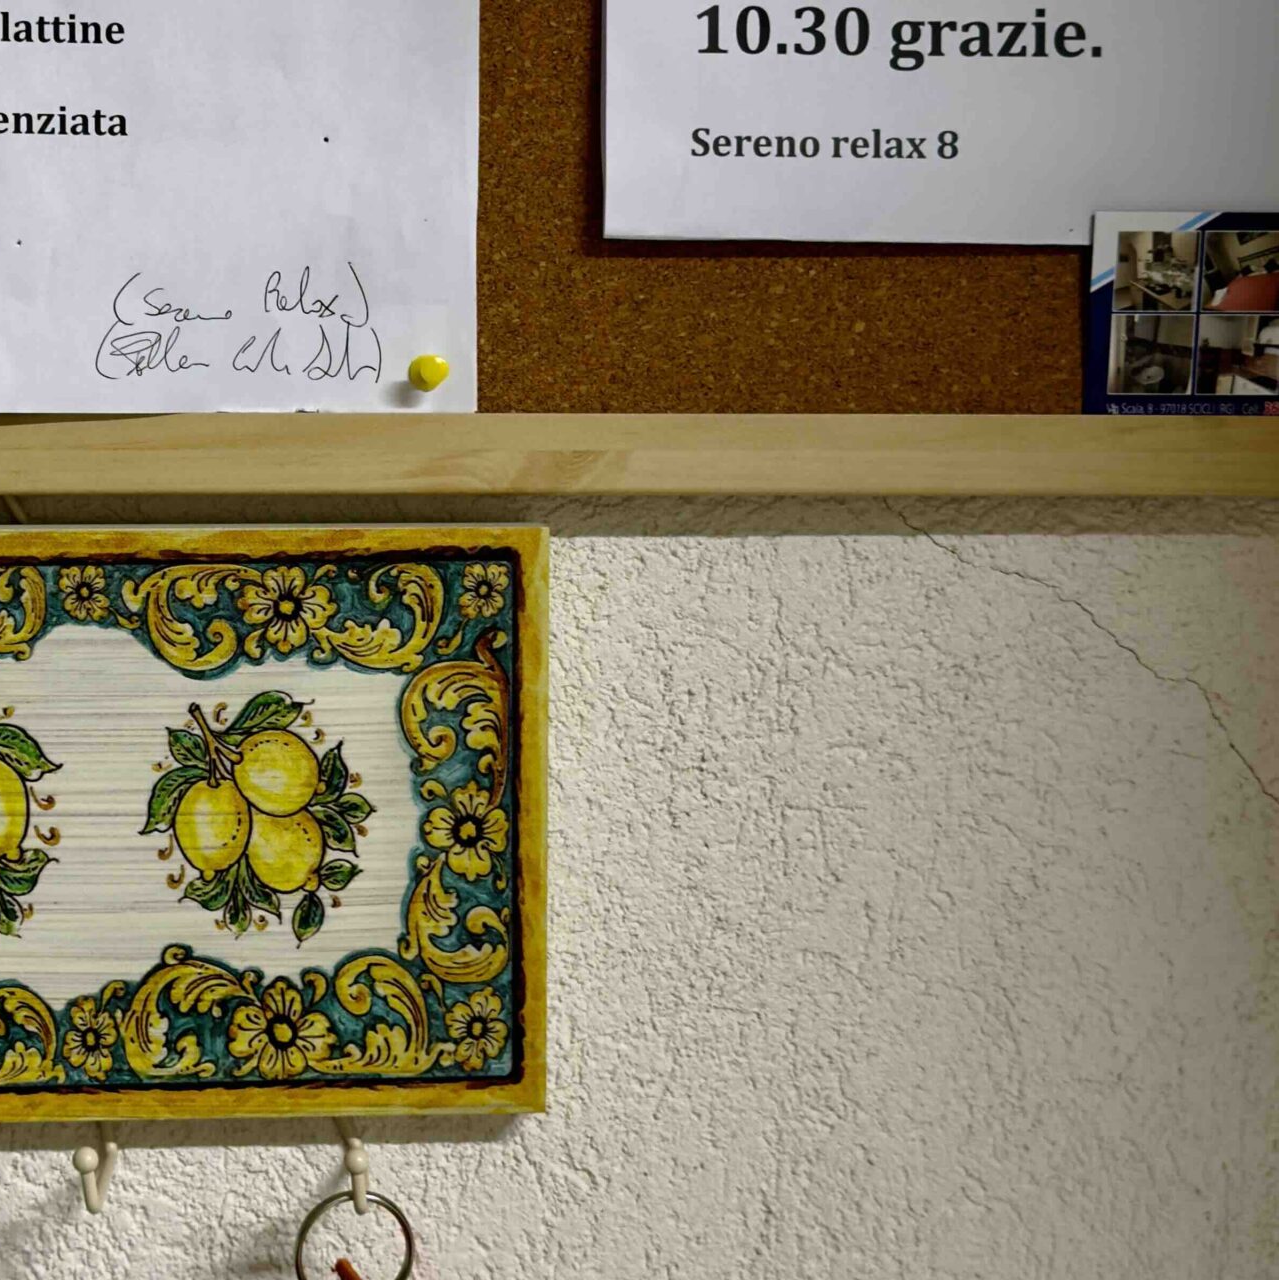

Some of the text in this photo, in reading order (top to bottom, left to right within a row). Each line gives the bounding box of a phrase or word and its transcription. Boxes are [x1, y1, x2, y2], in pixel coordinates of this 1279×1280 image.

[1, 12, 125, 45] lattine
[696, 5, 1104, 71] 10.30 grazie.
[691, 128, 959, 159] Sereno relax 8
